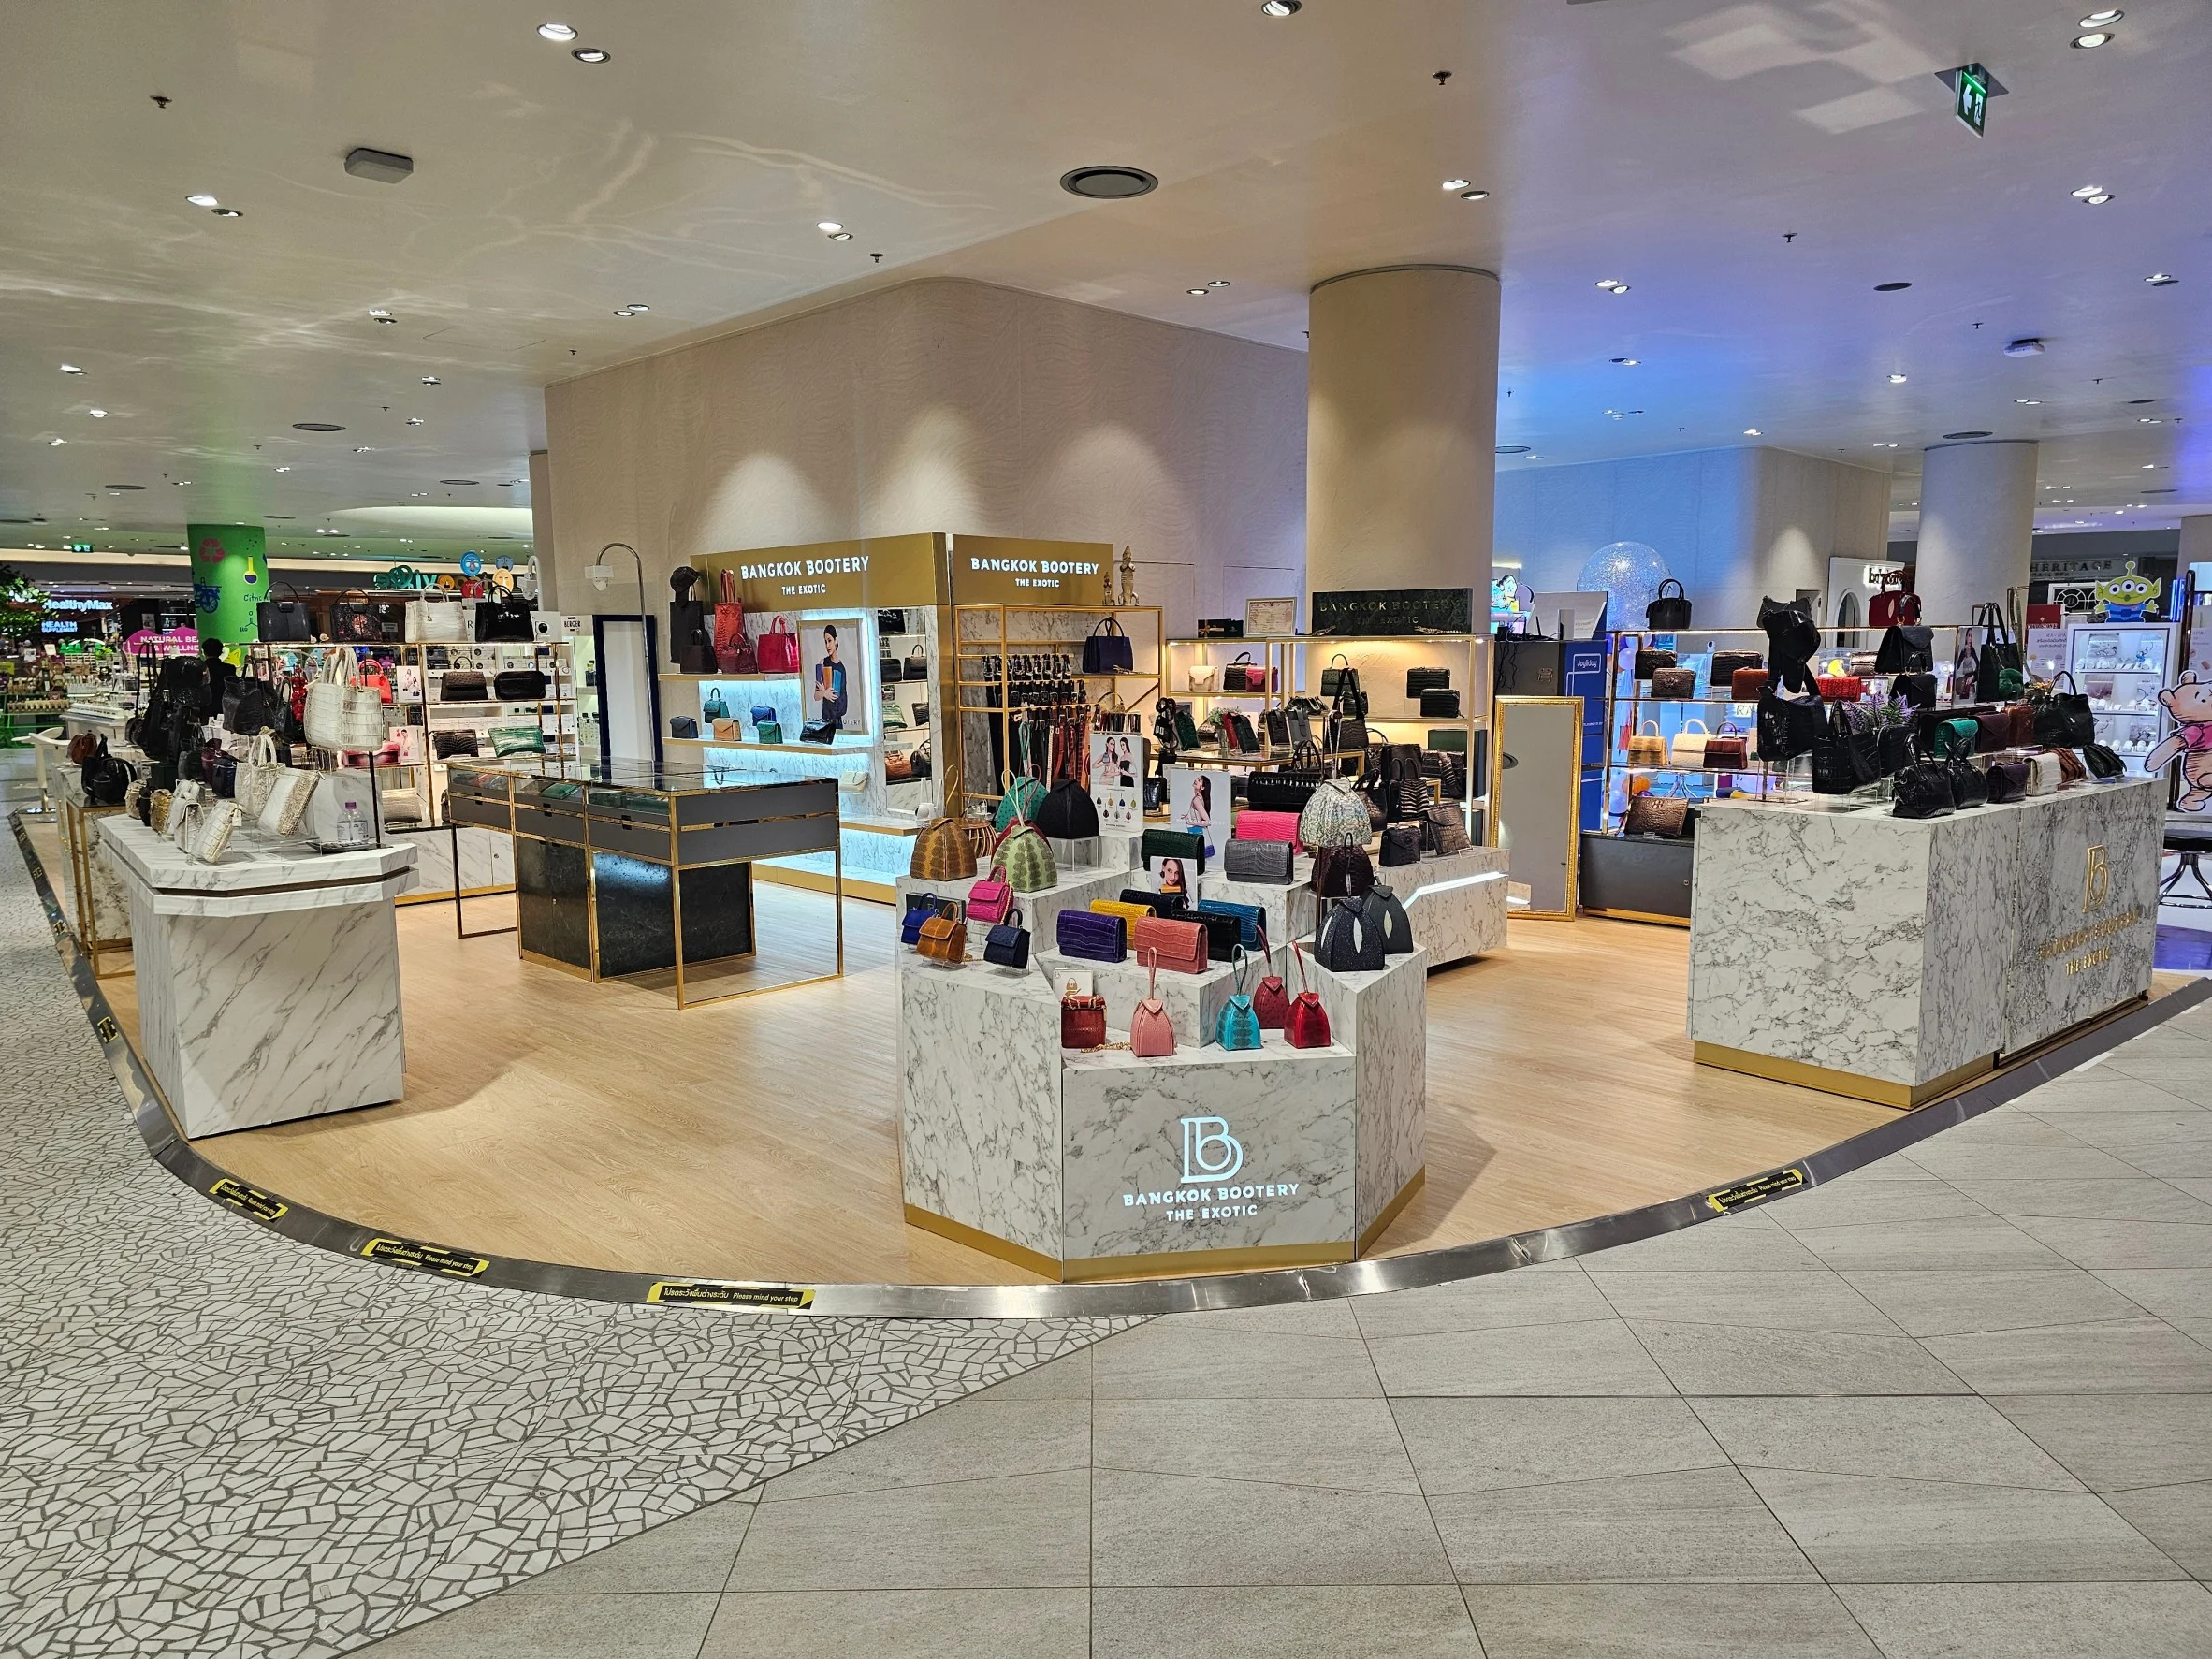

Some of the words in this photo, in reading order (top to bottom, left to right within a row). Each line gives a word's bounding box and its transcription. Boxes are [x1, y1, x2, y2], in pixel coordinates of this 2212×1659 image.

[741, 561, 802, 580] BANGKOK
[806, 556, 869, 575] BOOTERY
[970, 558, 1038, 573] BANGKOK
[1041, 560, 1099, 575] BOOTERY
[781, 586, 795, 595] THE
[798, 584, 826, 595] EXOTIC
[1014, 578, 1030, 587] THE
[1032, 578, 1060, 588] EXOTIC
[1319, 601, 1387, 612] BANGKOK
[2066, 960, 2080, 976] THE
[2083, 945, 2110, 969] EXOTIC
[1123, 1188, 1212, 1207] BANGKOK
[1217, 1183, 1300, 1201] BOOTERY
[1166, 1209, 1194, 1222] THE
[1201, 1204, 1258, 1219] EXOTIC
